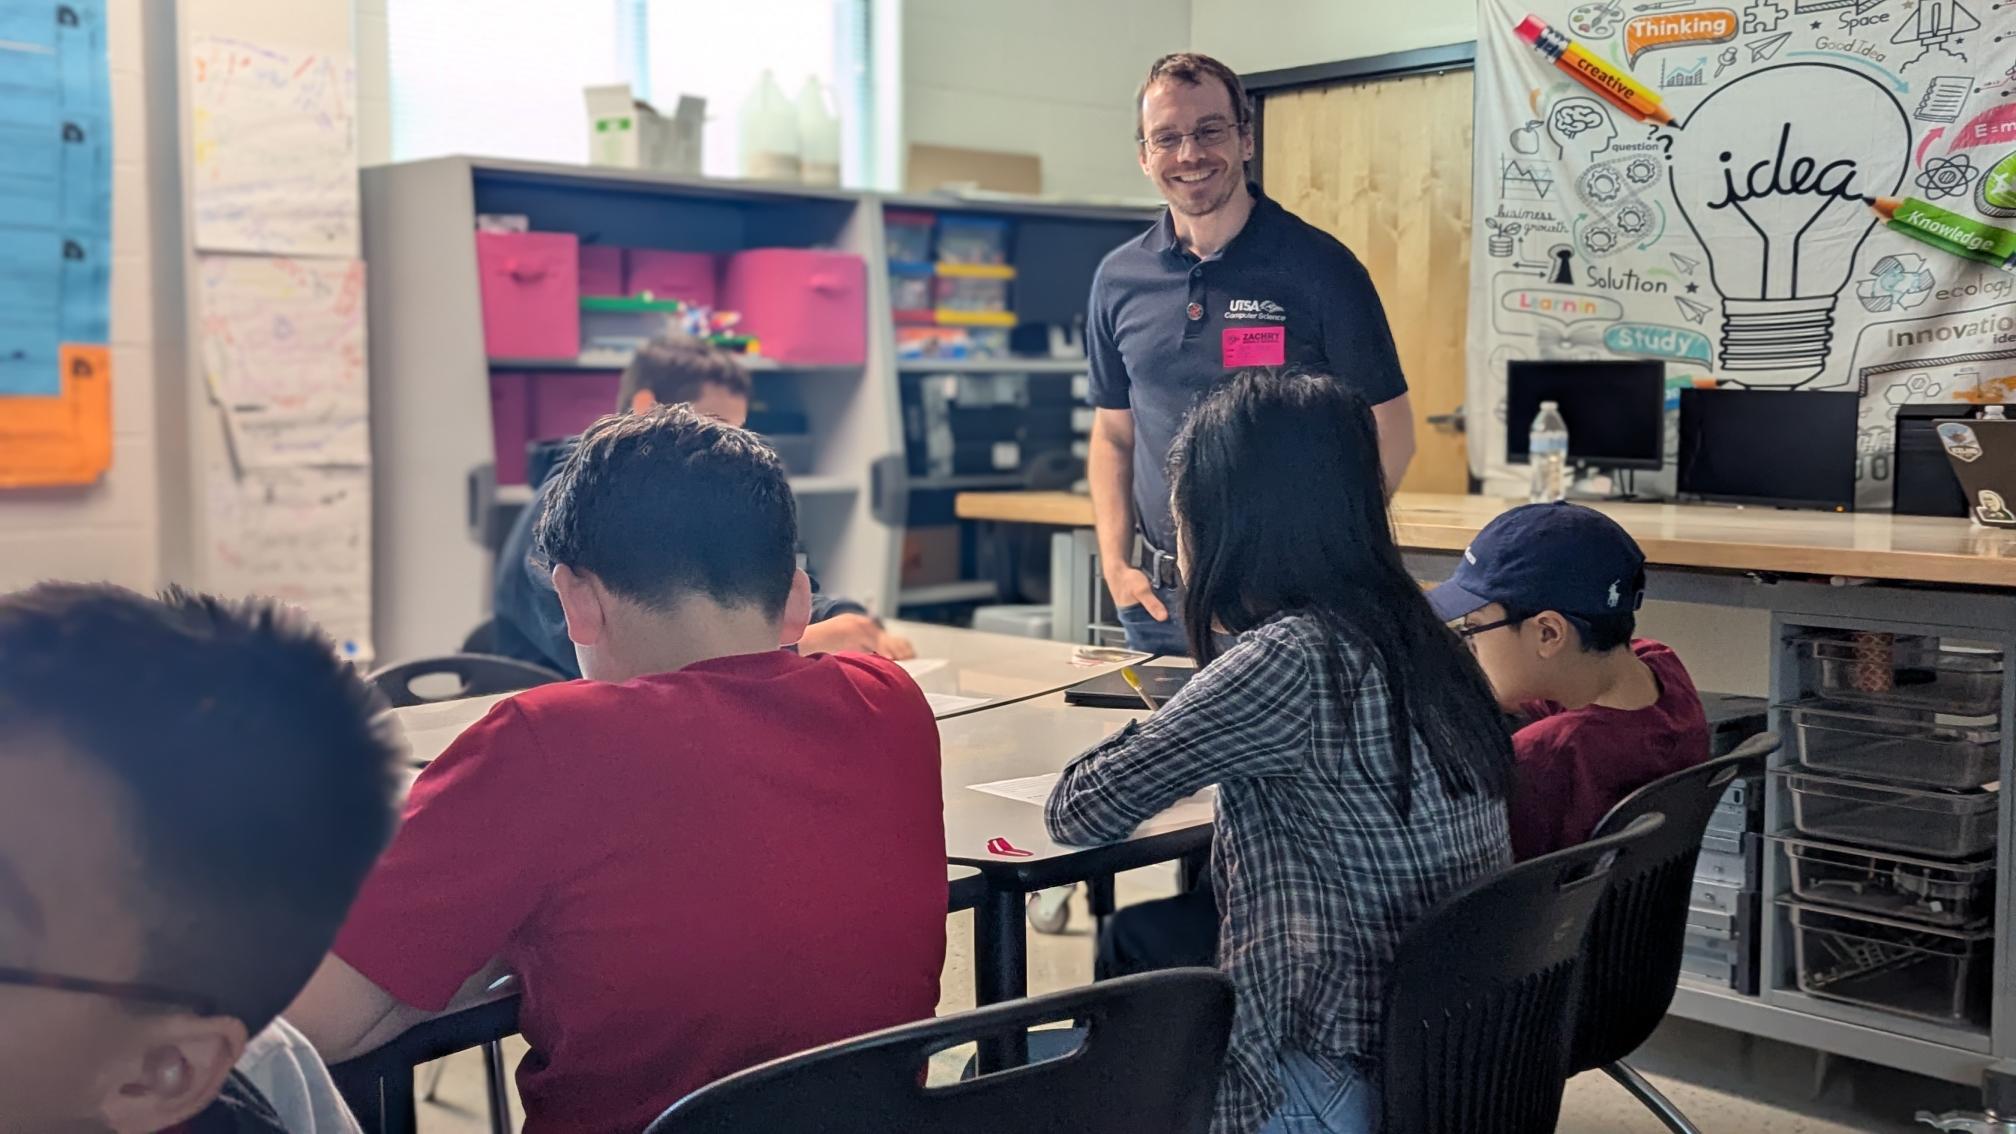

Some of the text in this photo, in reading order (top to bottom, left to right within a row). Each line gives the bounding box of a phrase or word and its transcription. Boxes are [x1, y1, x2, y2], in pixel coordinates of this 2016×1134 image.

[1632, 17, 1727, 37] Thinking
[1838, 11, 1890, 36] Space
[1815, 36, 1886, 63] Good Idea
[1577, 57, 1635, 100] creative
[1612, 142, 1659, 152] question
[1706, 122, 1863, 210] idea
[1524, 221, 1569, 236] growth
[1908, 210, 1995, 251] Knowledge
[1586, 265, 1668, 293] Solution
[1935, 272, 2014, 300] ecology
[1224, 311, 1287, 321] Computer Science
[1229, 299, 1261, 312] UTSA
[1618, 328, 1692, 357] Study
